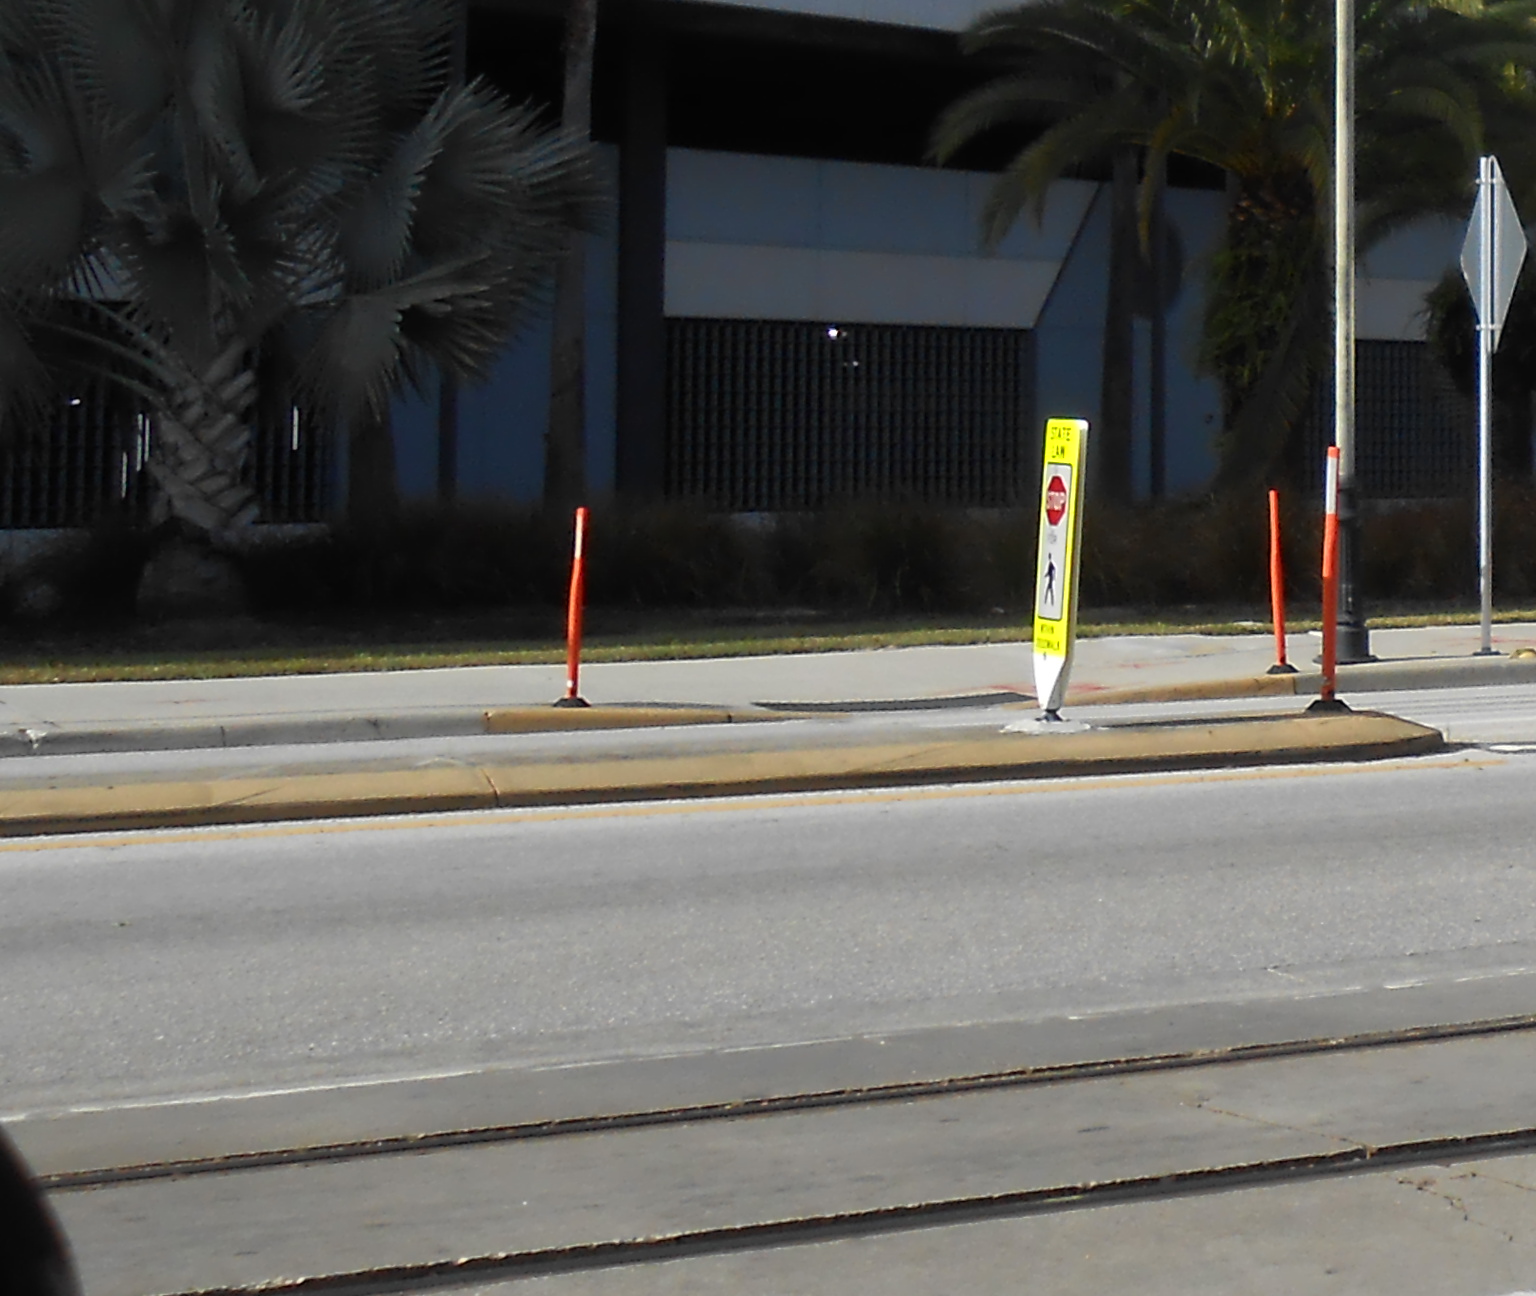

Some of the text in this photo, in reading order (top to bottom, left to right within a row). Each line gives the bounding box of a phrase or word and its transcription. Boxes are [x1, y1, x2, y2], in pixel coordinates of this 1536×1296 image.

[1050, 427, 1072, 442] STATE
[1051, 444, 1065, 459] LAW
[1046, 491, 1067, 512] STOP
